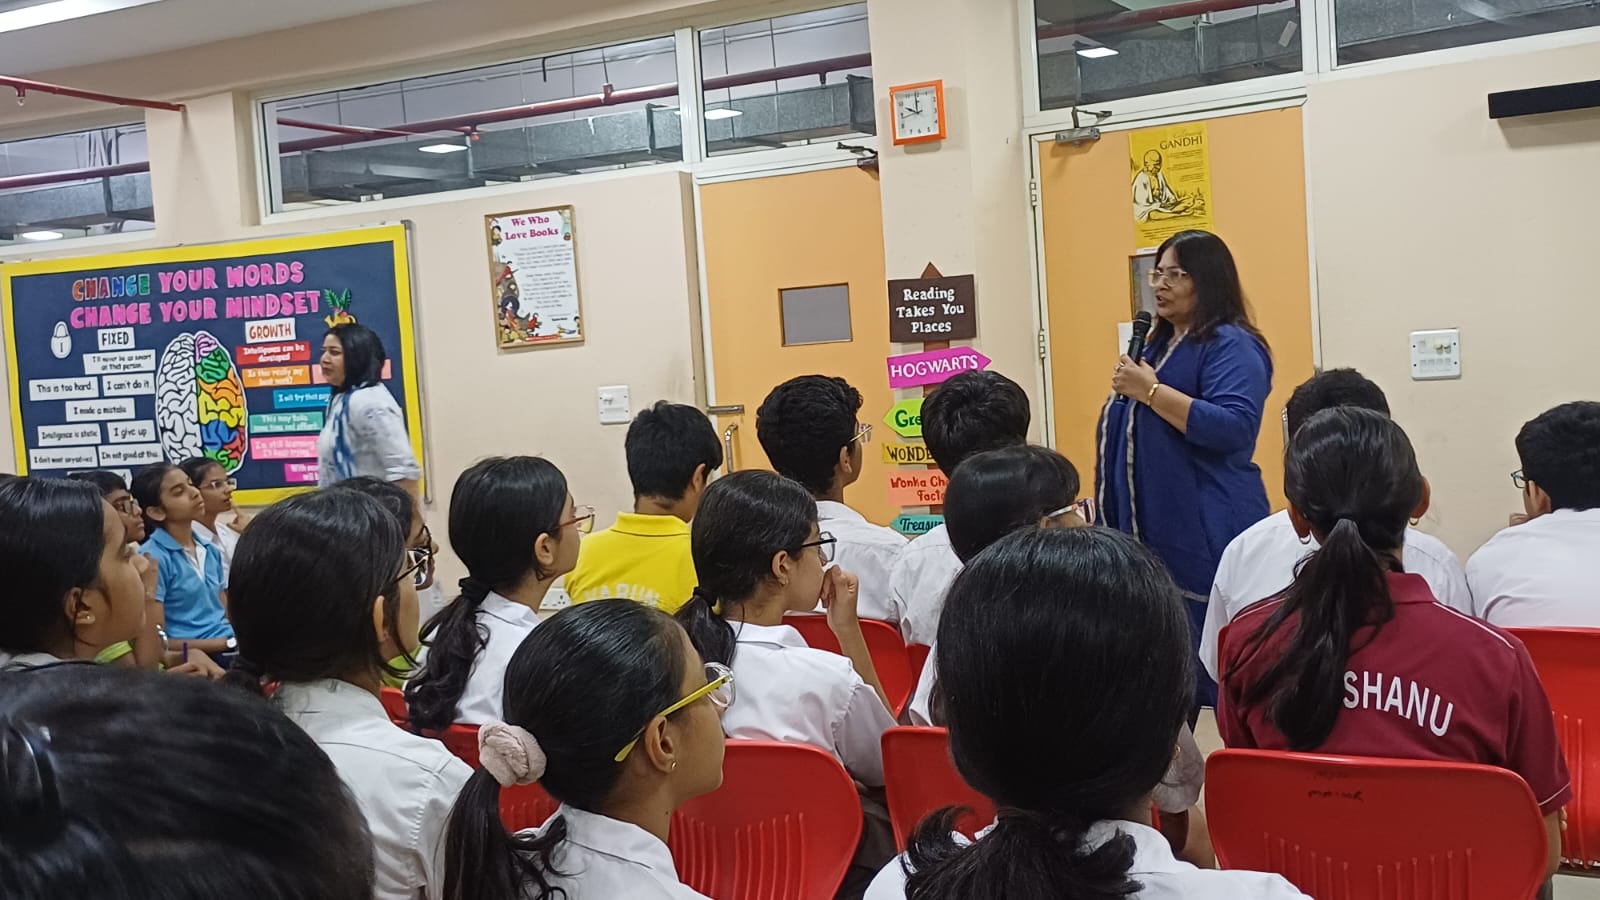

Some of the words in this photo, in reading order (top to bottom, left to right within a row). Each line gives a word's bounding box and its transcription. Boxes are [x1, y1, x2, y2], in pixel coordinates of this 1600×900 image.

[1160, 136, 1203, 150] GANDHI
[511, 218, 526, 227] We
[528, 215, 550, 225] Who
[505, 231, 528, 241] Love
[530, 227, 559, 238] Books
[72, 274, 151, 301] CHANGE
[158, 267, 218, 293] YOUR
[226, 261, 304, 288] WORDS
[903, 287, 955, 302] Reading
[70, 303, 152, 328] CHANGE
[159, 297, 218, 322] YOUR
[226, 290, 320, 318] MINDSET
[896, 306, 935, 318] Takes
[942, 303, 965, 315] You
[249, 323, 292, 339] GROWTH
[911, 321, 952, 333] Places
[101, 332, 129, 346] FIXED
[890, 355, 979, 378] HOGWARTS
[37, 384, 51, 393] This
[53, 384, 59, 392] is
[61, 383, 73, 392] too
[107, 381, 112, 390] I
[113, 381, 131, 390] can't
[133, 380, 142, 389] do
[73, 406, 78, 415] I
[114, 427, 119, 437] I
[120, 427, 136, 439] give
[138, 428, 147, 438] up
[891, 476, 926, 488] Wonka
[930, 475, 946, 488] Ch
[1343, 670, 1454, 737] SHANU
